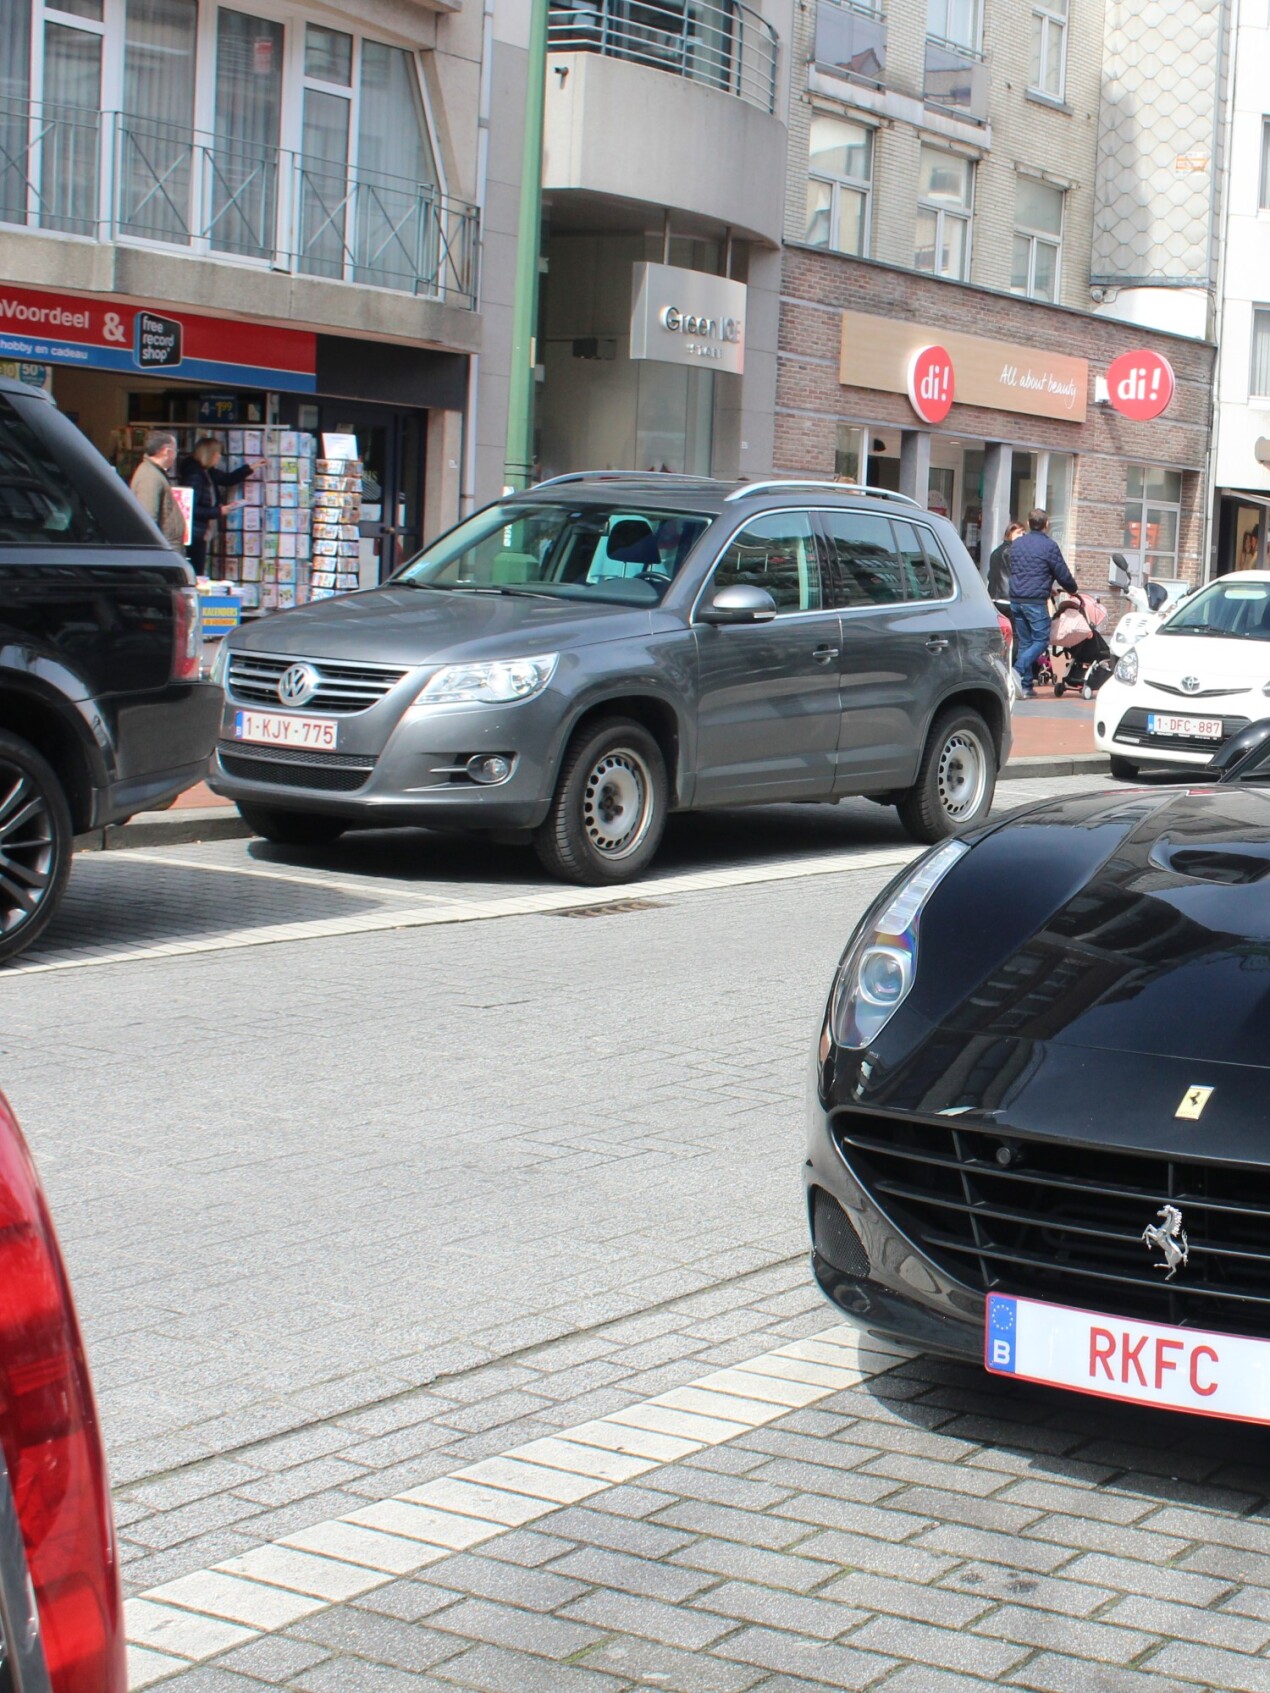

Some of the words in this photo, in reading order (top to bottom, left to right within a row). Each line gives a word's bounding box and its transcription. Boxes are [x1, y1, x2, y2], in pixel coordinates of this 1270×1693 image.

[102, 312, 127, 343] &
[142, 315, 164, 334] free
[661, 305, 717, 338] Green
[35, 346, 49, 355] en
[51, 347, 88, 360] cadeau
[142, 333, 175, 347] record
[920, 365, 949, 402] di!
[1000, 364, 1017, 386] All
[1019, 369, 1048, 391] about
[1047, 374, 1078, 410] beauty
[1117, 368, 1162, 401] di!
[246, 716, 334, 745] 1-KJY-775
[1157, 717, 1220, 734] 1-DFC-887
[993, 1339, 1011, 1365] B
[1089, 1326, 1220, 1397] RKFC
